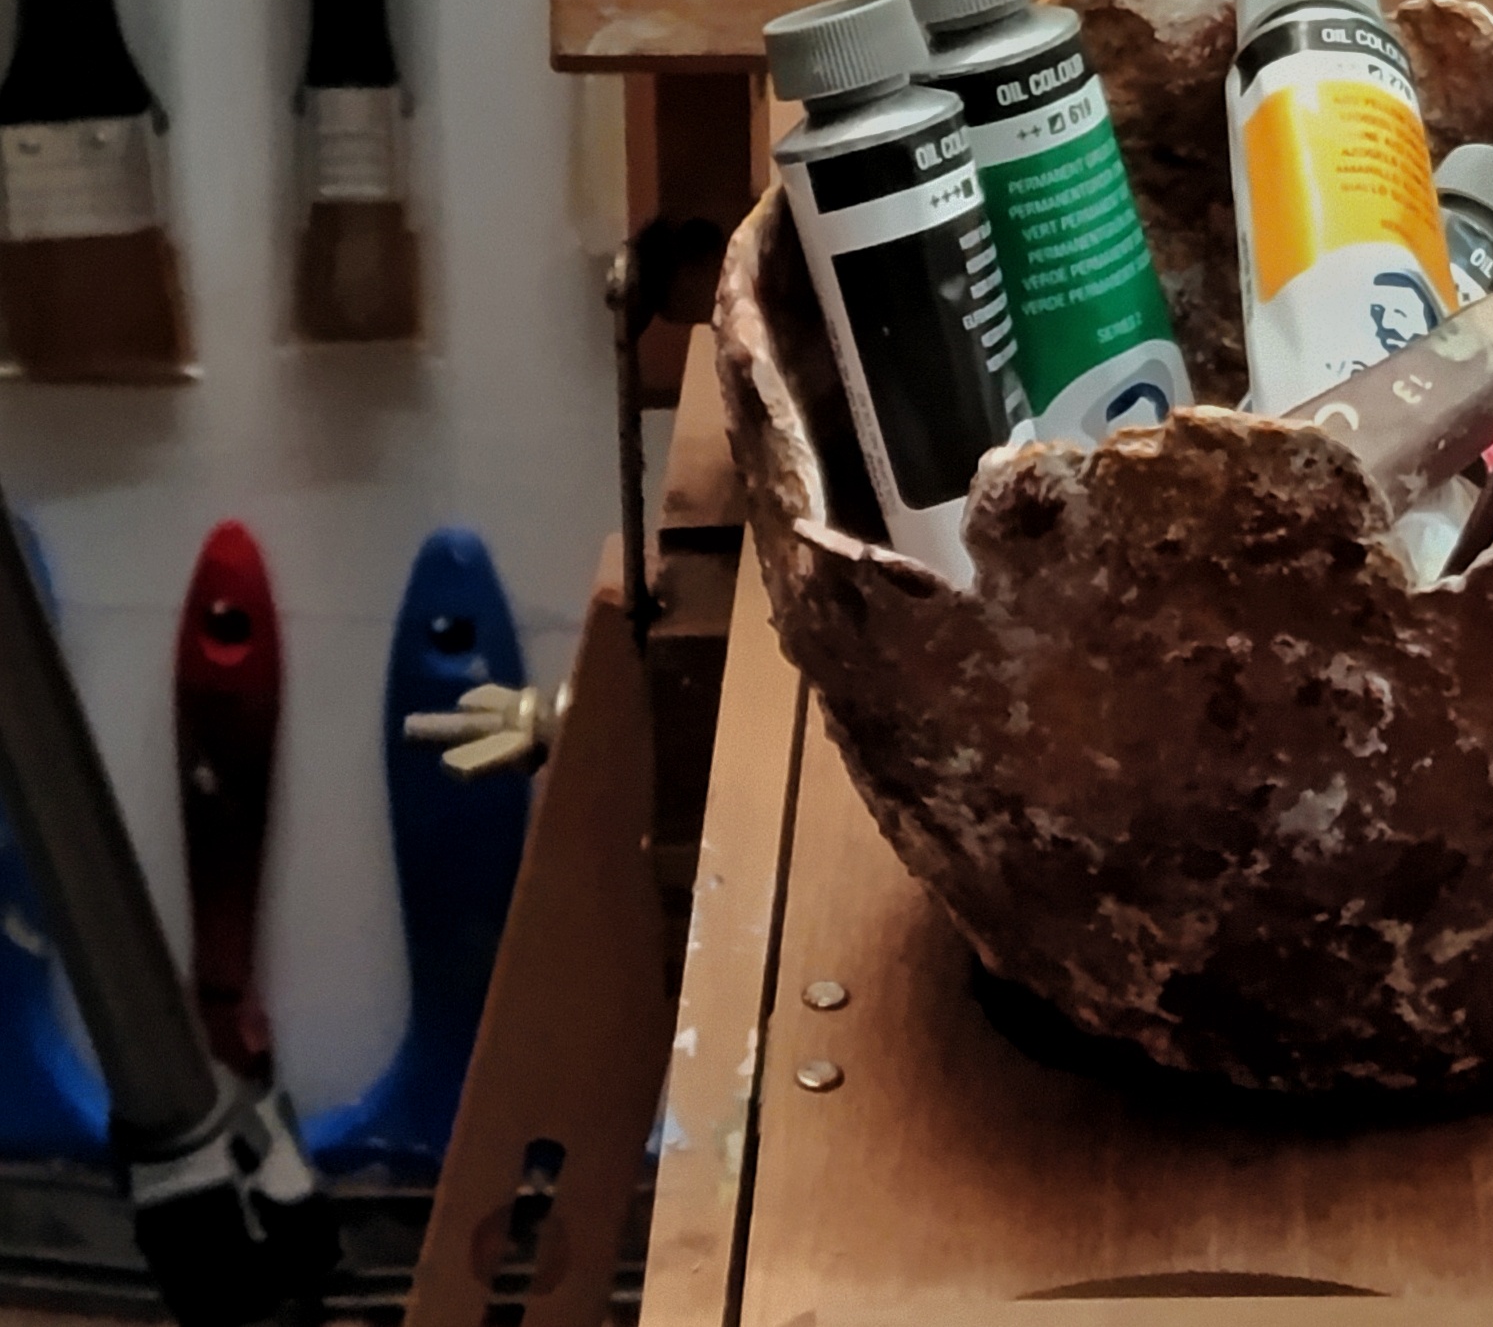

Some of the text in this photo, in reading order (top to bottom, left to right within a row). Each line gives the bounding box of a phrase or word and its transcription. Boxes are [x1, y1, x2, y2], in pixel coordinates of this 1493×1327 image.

[1320, 27, 1352, 45] OIL
[996, 52, 1085, 107] OIL COLOUR
[914, 143, 943, 171] OIL
